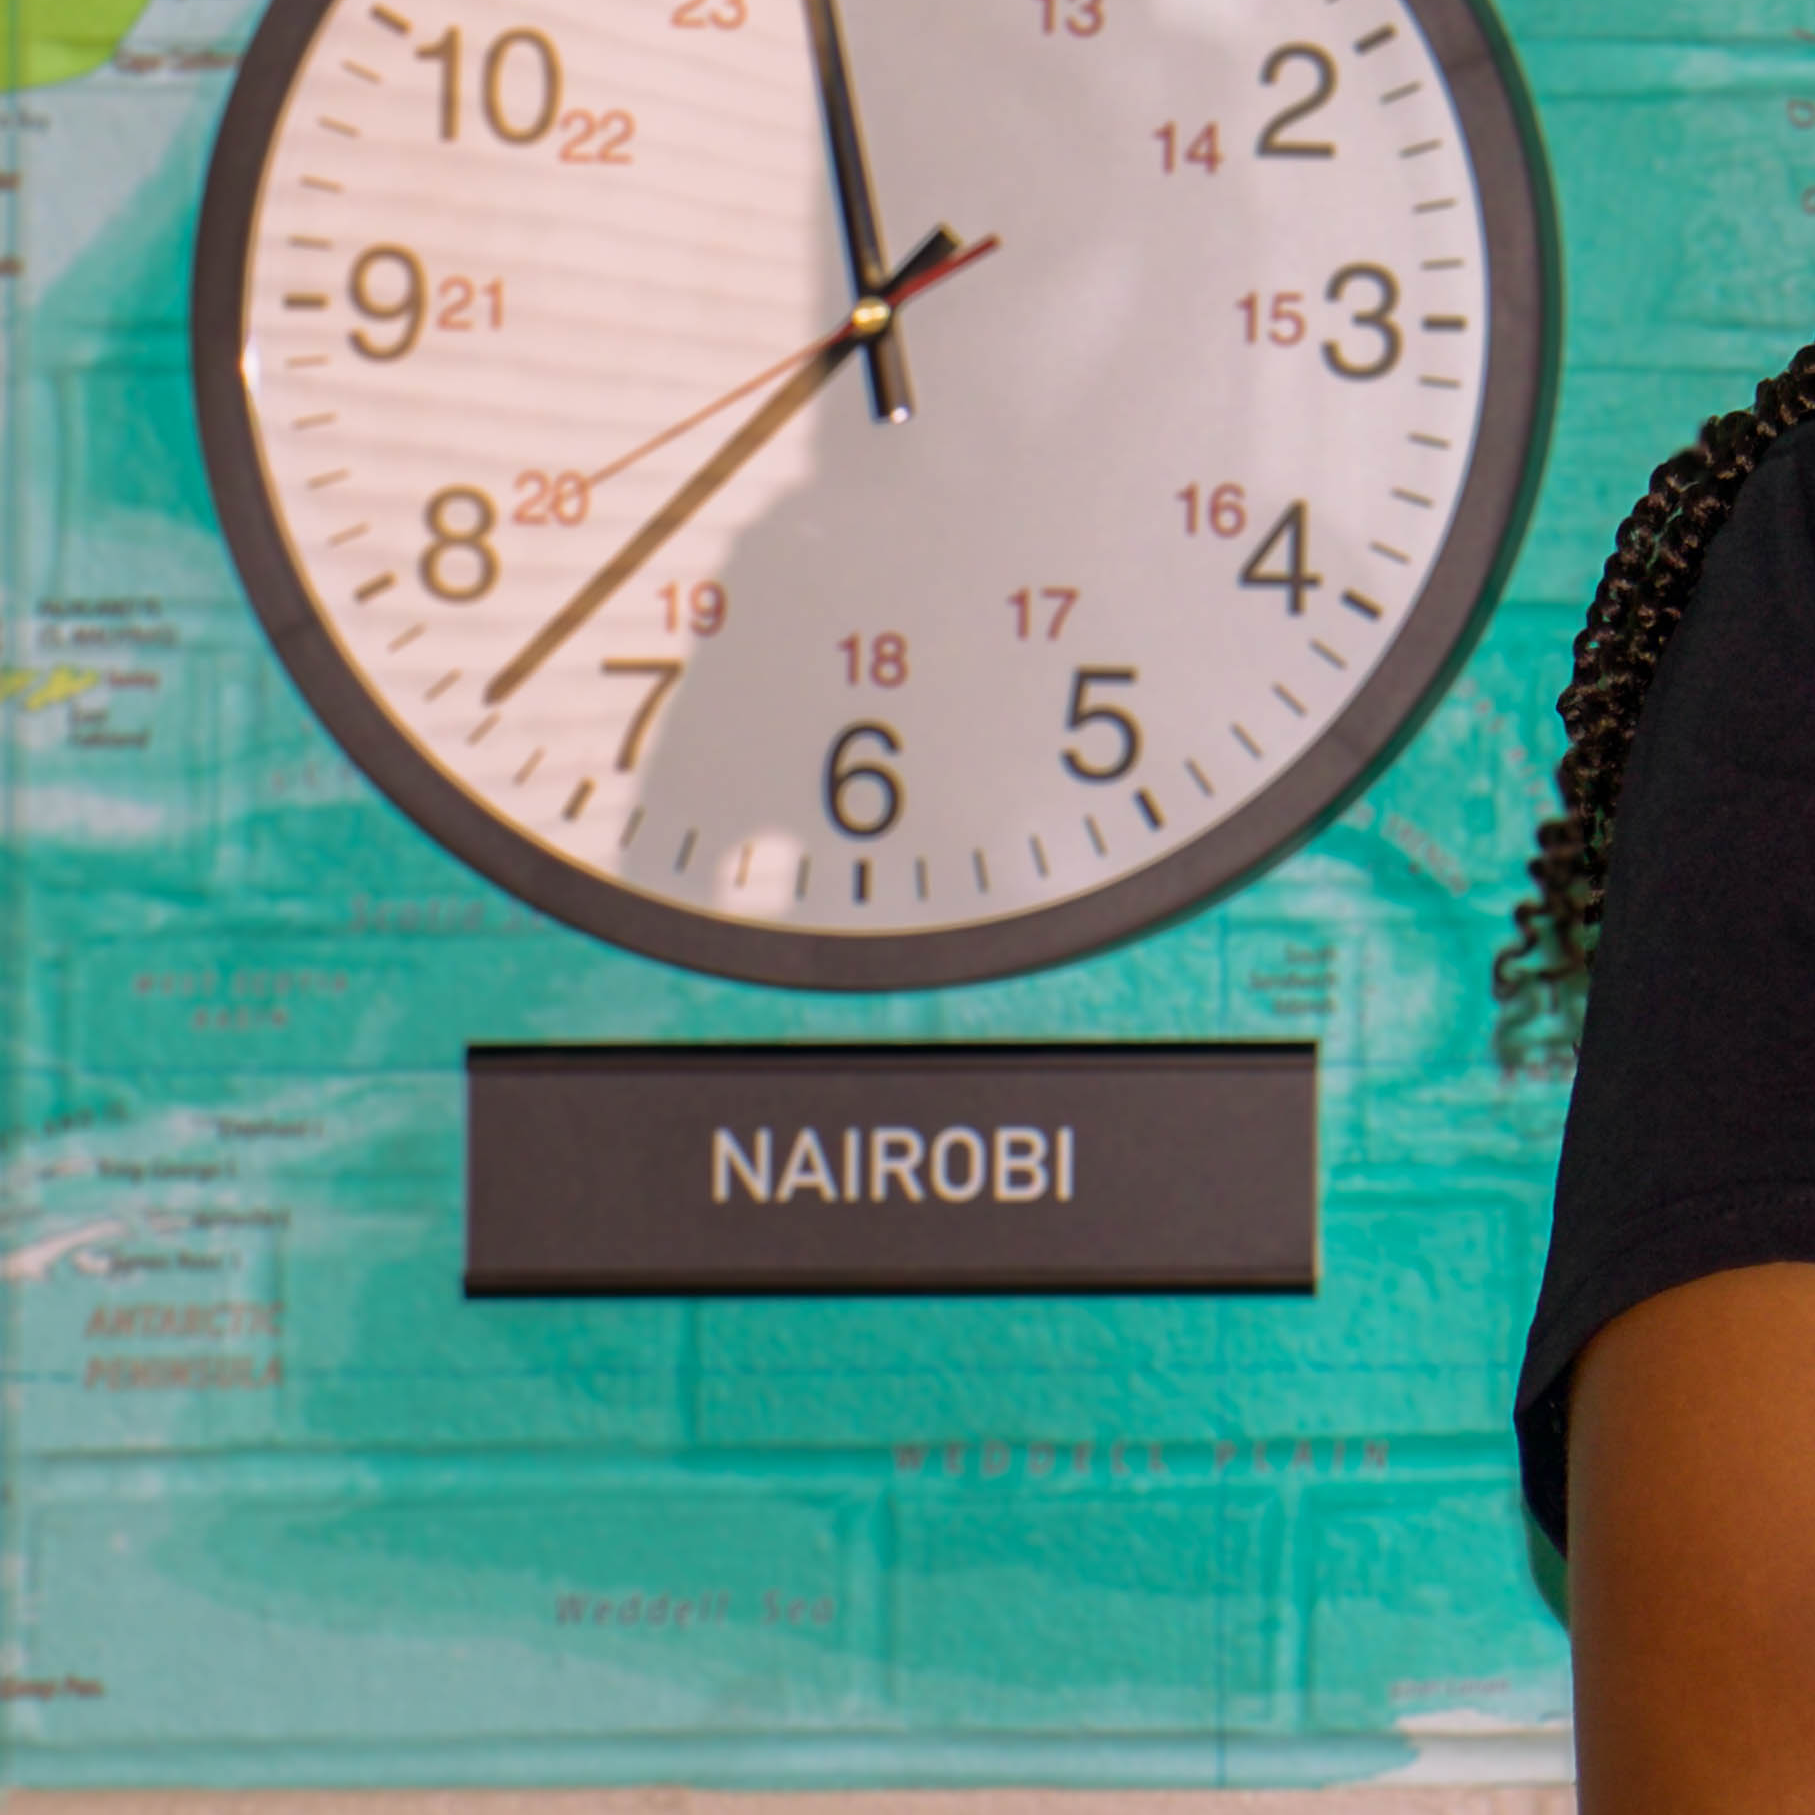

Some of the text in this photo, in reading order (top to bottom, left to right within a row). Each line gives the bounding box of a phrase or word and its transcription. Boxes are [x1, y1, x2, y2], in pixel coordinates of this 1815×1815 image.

[415, 27, 563, 147] 10
[1255, 42, 1338, 160] 2
[558, 108, 636, 165] 22
[1155, 122, 1222, 174] 14
[346, 243, 428, 364] 9
[436, 275, 504, 332] 21
[1238, 291, 1307, 347] 15
[1321, 261, 1403, 382] 3
[512, 469, 591, 527] 20
[1179, 482, 1248, 538] 16
[417, 486, 500, 604] 8
[1238, 500, 1322, 617] 4
[658, 579, 728, 637] 19
[1009, 586, 1079, 640] 17
[840, 632, 909, 688] 18
[600, 658, 684, 774] 7
[1061, 666, 1142, 784] 5
[823, 721, 903, 840] 6
[710, 1125, 1075, 1204] NAIROBI
[761, 1589, 838, 1626] Sea
